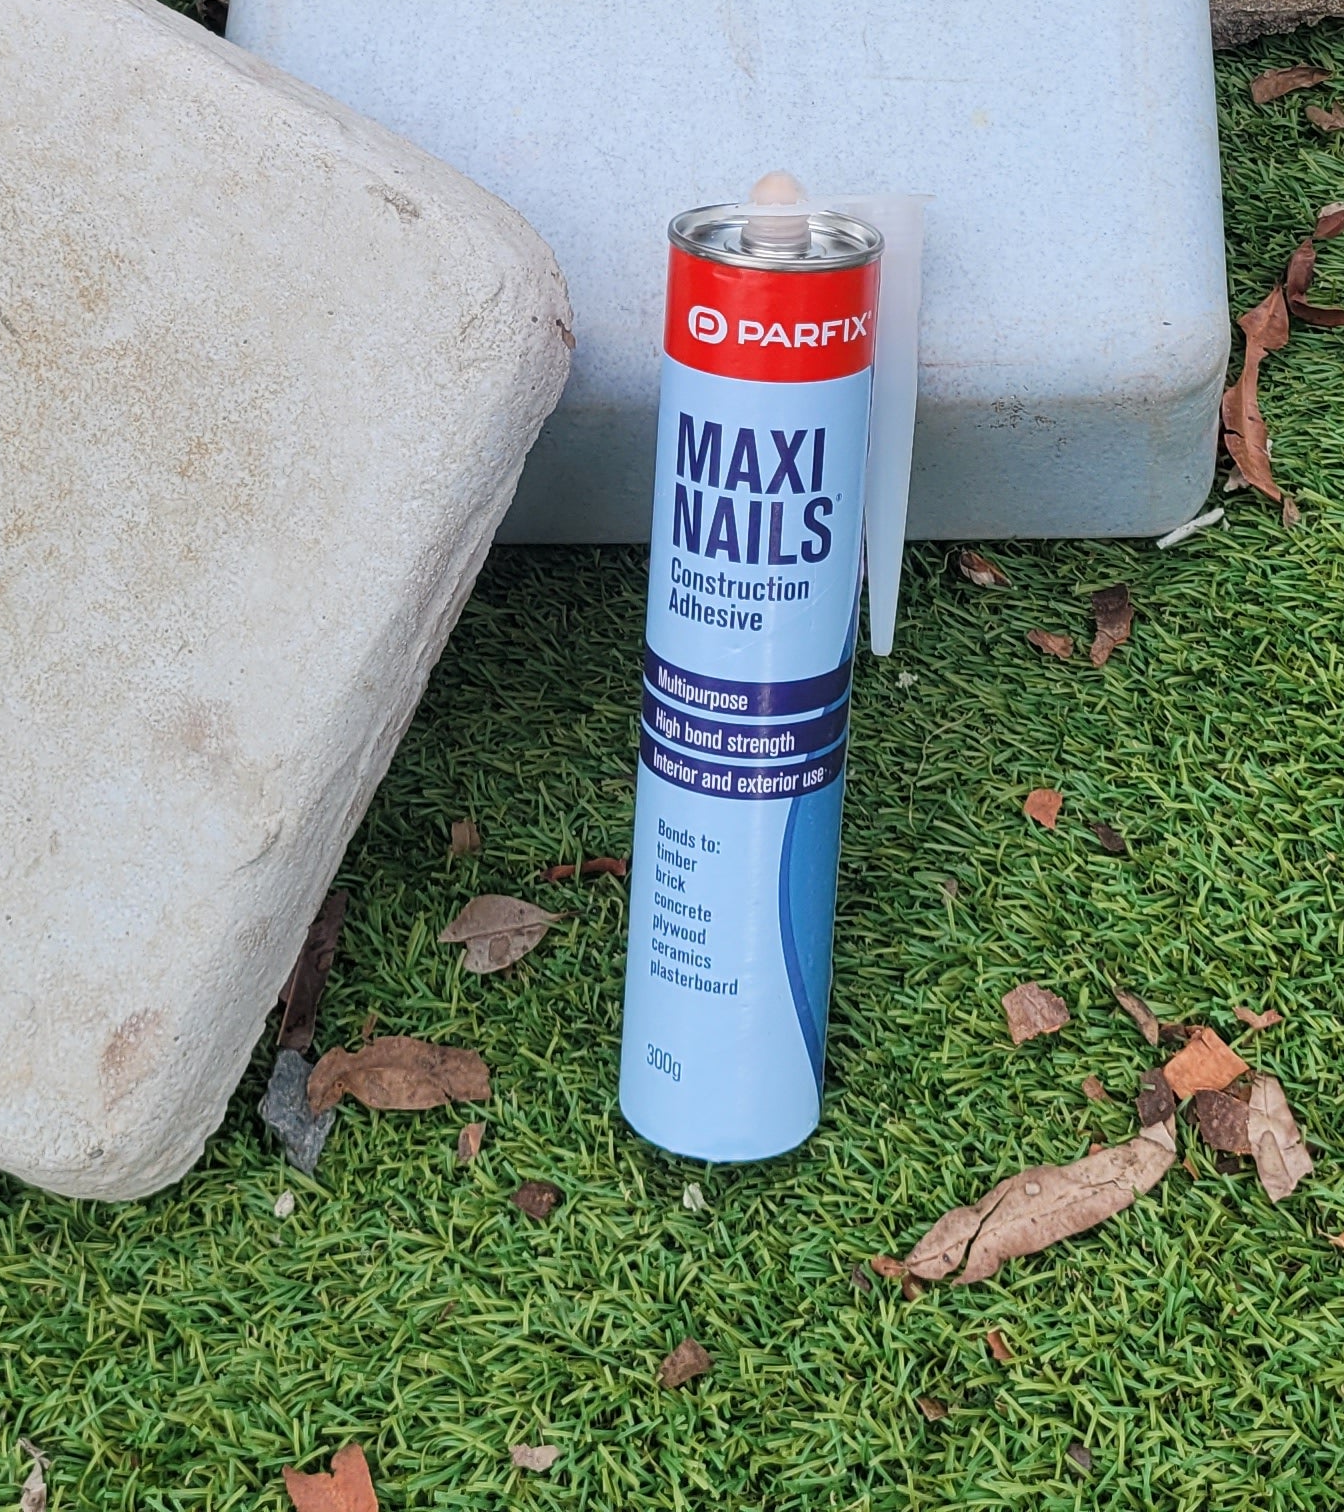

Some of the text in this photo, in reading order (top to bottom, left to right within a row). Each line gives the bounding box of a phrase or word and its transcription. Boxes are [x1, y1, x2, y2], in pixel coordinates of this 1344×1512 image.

[737, 315, 869, 348] PARFIX
[675, 410, 827, 495] MAXI
[671, 482, 834, 566] NAILS
[670, 556, 810, 602] Construction
[668, 587, 763, 632] Adhesive
[657, 665, 749, 712] Multipurpose
[655, 707, 795, 757] High bond strength
[653, 747, 825, 795] Interior and exterior use
[658, 818, 721, 854] Bonds to:
[656, 843, 698, 873] timber
[655, 864, 687, 894] brick
[654, 891, 712, 924] concrete
[652, 913, 707, 946] plywood
[651, 938, 712, 970] ceramics
[650, 959, 739, 996] plasterboard
[646, 1043, 682, 1083] 300g
